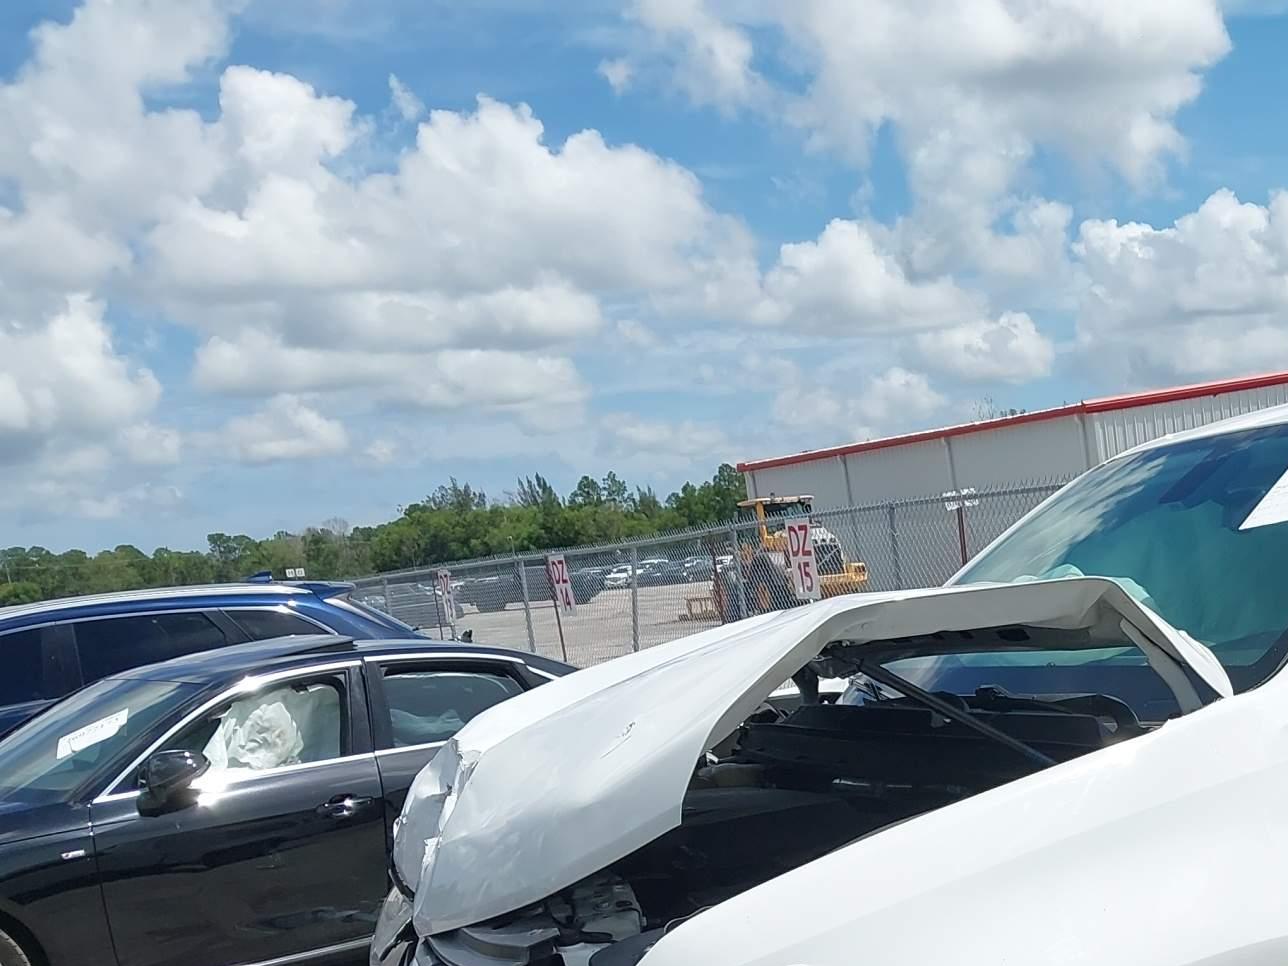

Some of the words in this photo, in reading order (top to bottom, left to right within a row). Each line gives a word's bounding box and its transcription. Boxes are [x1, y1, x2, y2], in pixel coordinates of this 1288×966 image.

[788, 524, 812, 557] DZ
[551, 559, 568, 585] DZ
[798, 561, 814, 593] 15
[560, 587, 573, 612] 14
